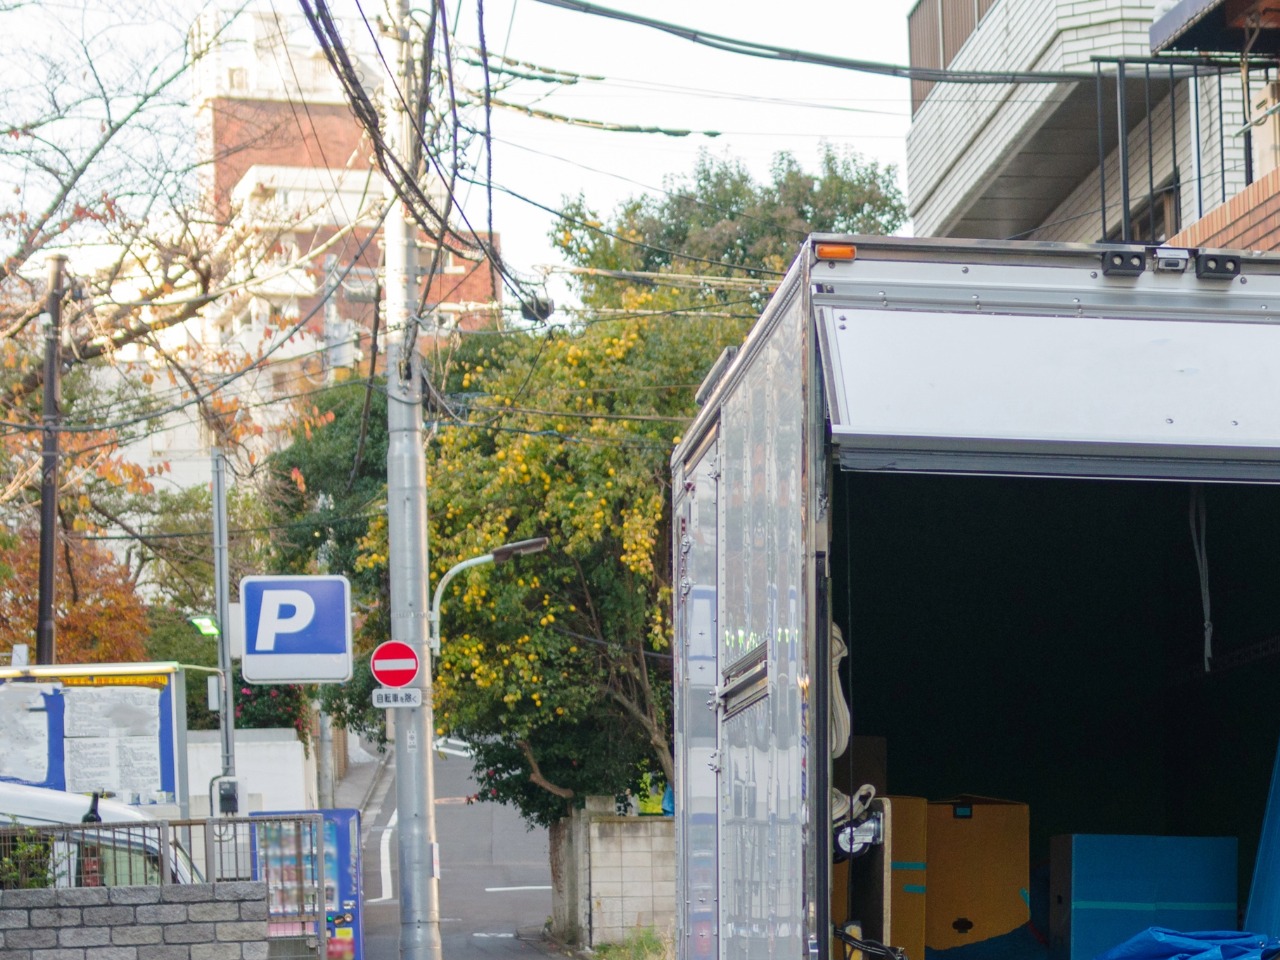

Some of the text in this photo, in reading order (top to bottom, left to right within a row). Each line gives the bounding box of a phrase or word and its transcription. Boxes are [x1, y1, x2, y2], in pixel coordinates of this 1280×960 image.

[255, 589, 316, 651] P
[376, 693, 417, 704] 自転車を除く
